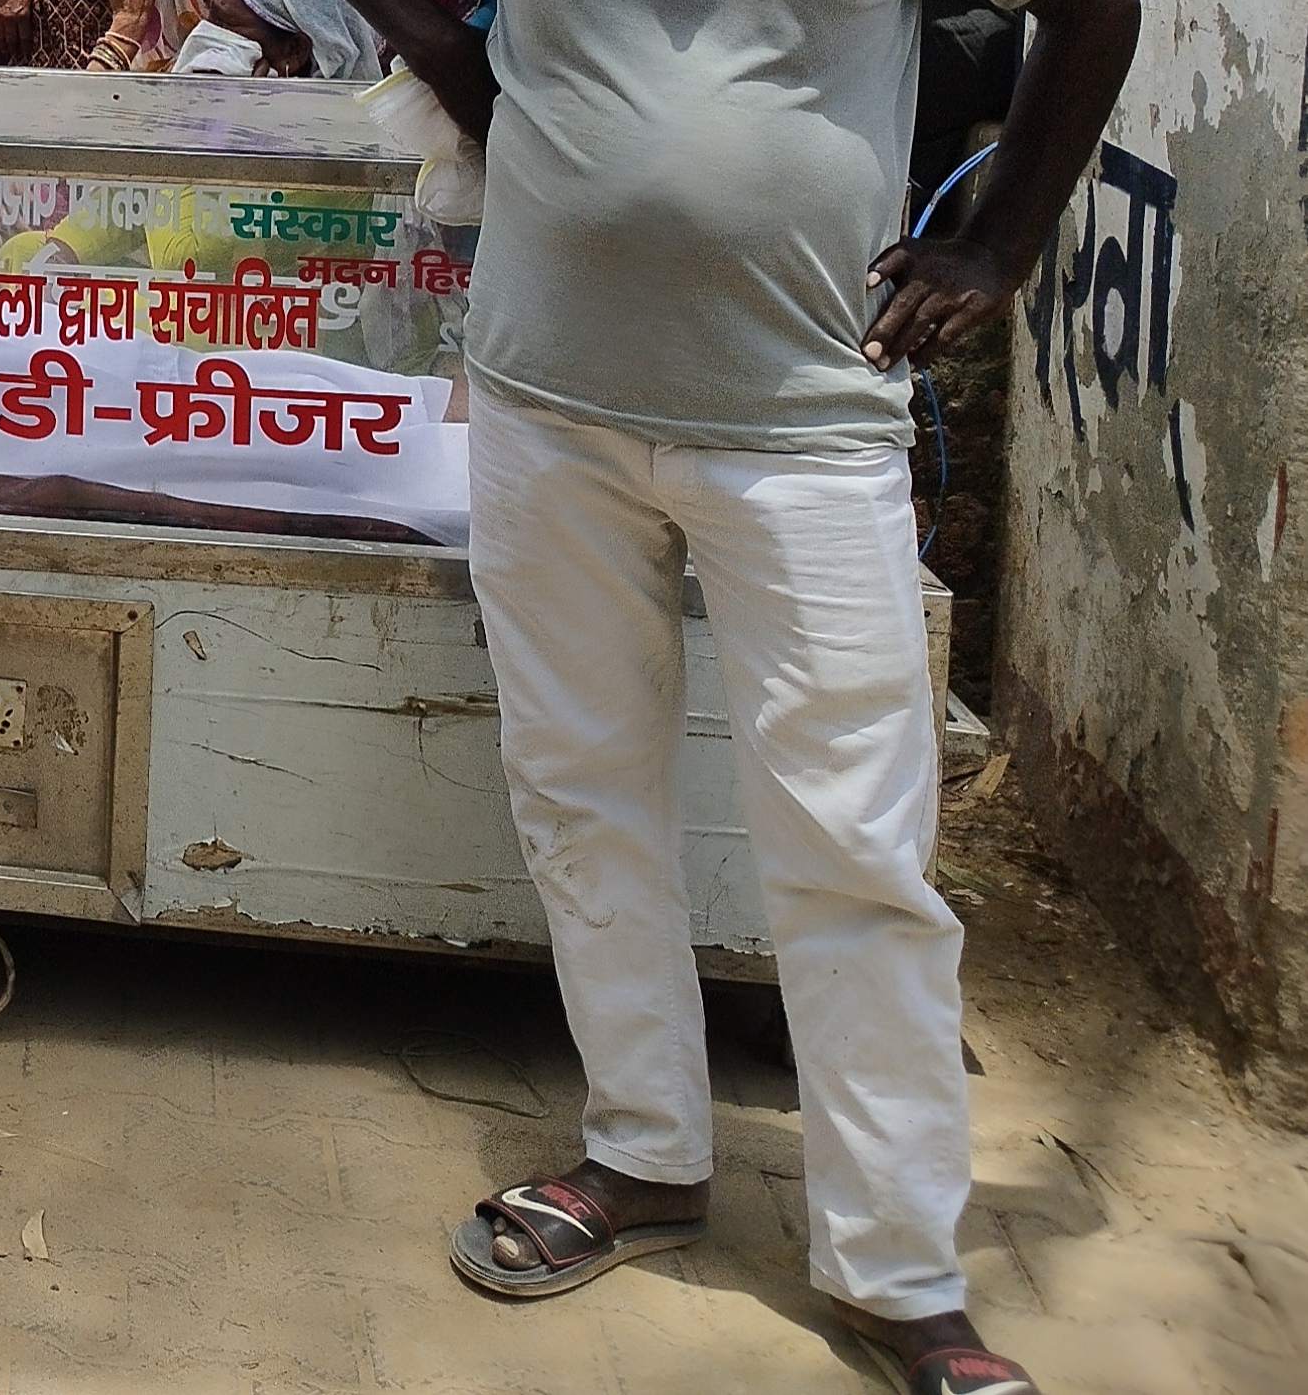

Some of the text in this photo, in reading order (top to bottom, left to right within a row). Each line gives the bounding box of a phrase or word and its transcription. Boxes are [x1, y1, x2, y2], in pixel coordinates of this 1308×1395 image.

[230, 192, 402, 247] संस्कार
[297, 256, 400, 288] मदन
[58, 273, 138, 346] द्वारा
[149, 257, 322, 350] संचालित
